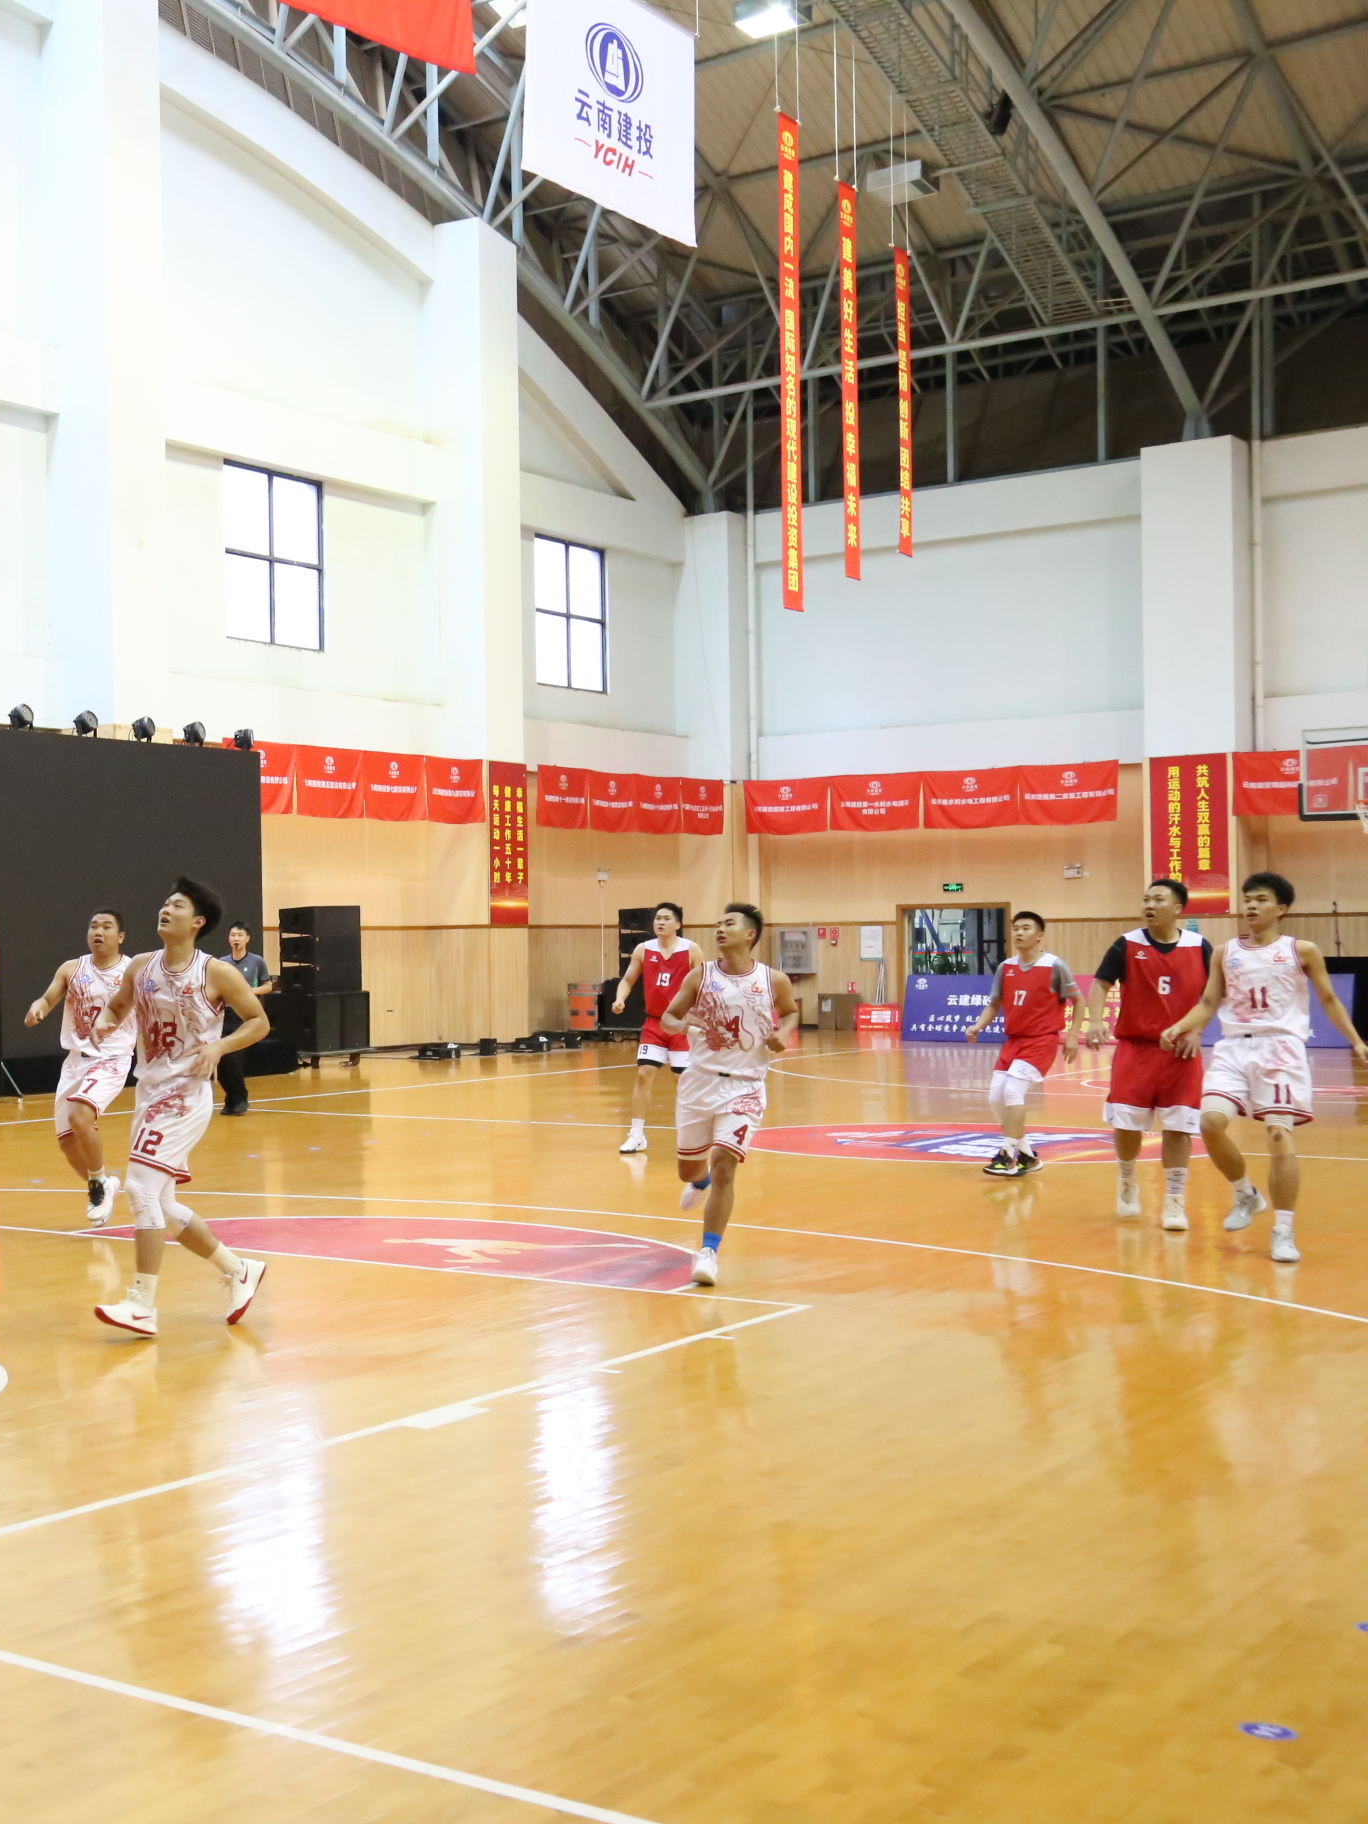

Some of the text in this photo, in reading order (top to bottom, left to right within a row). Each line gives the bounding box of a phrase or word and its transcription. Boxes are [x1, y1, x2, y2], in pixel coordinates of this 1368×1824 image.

[574, 88, 654, 160] 云南建投
[593, 139, 636, 177] YCIH
[492, 785, 501, 883] 每天运动一小时
[504, 786, 512, 883] 健康工作五十年
[516, 787, 524, 884] 幸福生活一辈子
[656, 972, 670, 987] 19
[1157, 975, 1171, 995] 6
[1013, 990, 1027, 1006] 17
[1249, 986, 1269, 1009] 11
[149, 1021, 177, 1048] 12
[725, 1015, 740, 1040] 4
[82, 1078, 98, 1095] 7
[1273, 1084, 1292, 1105] 11
[133, 1127, 164, 1157] 12
[733, 1124, 749, 1145] 4
